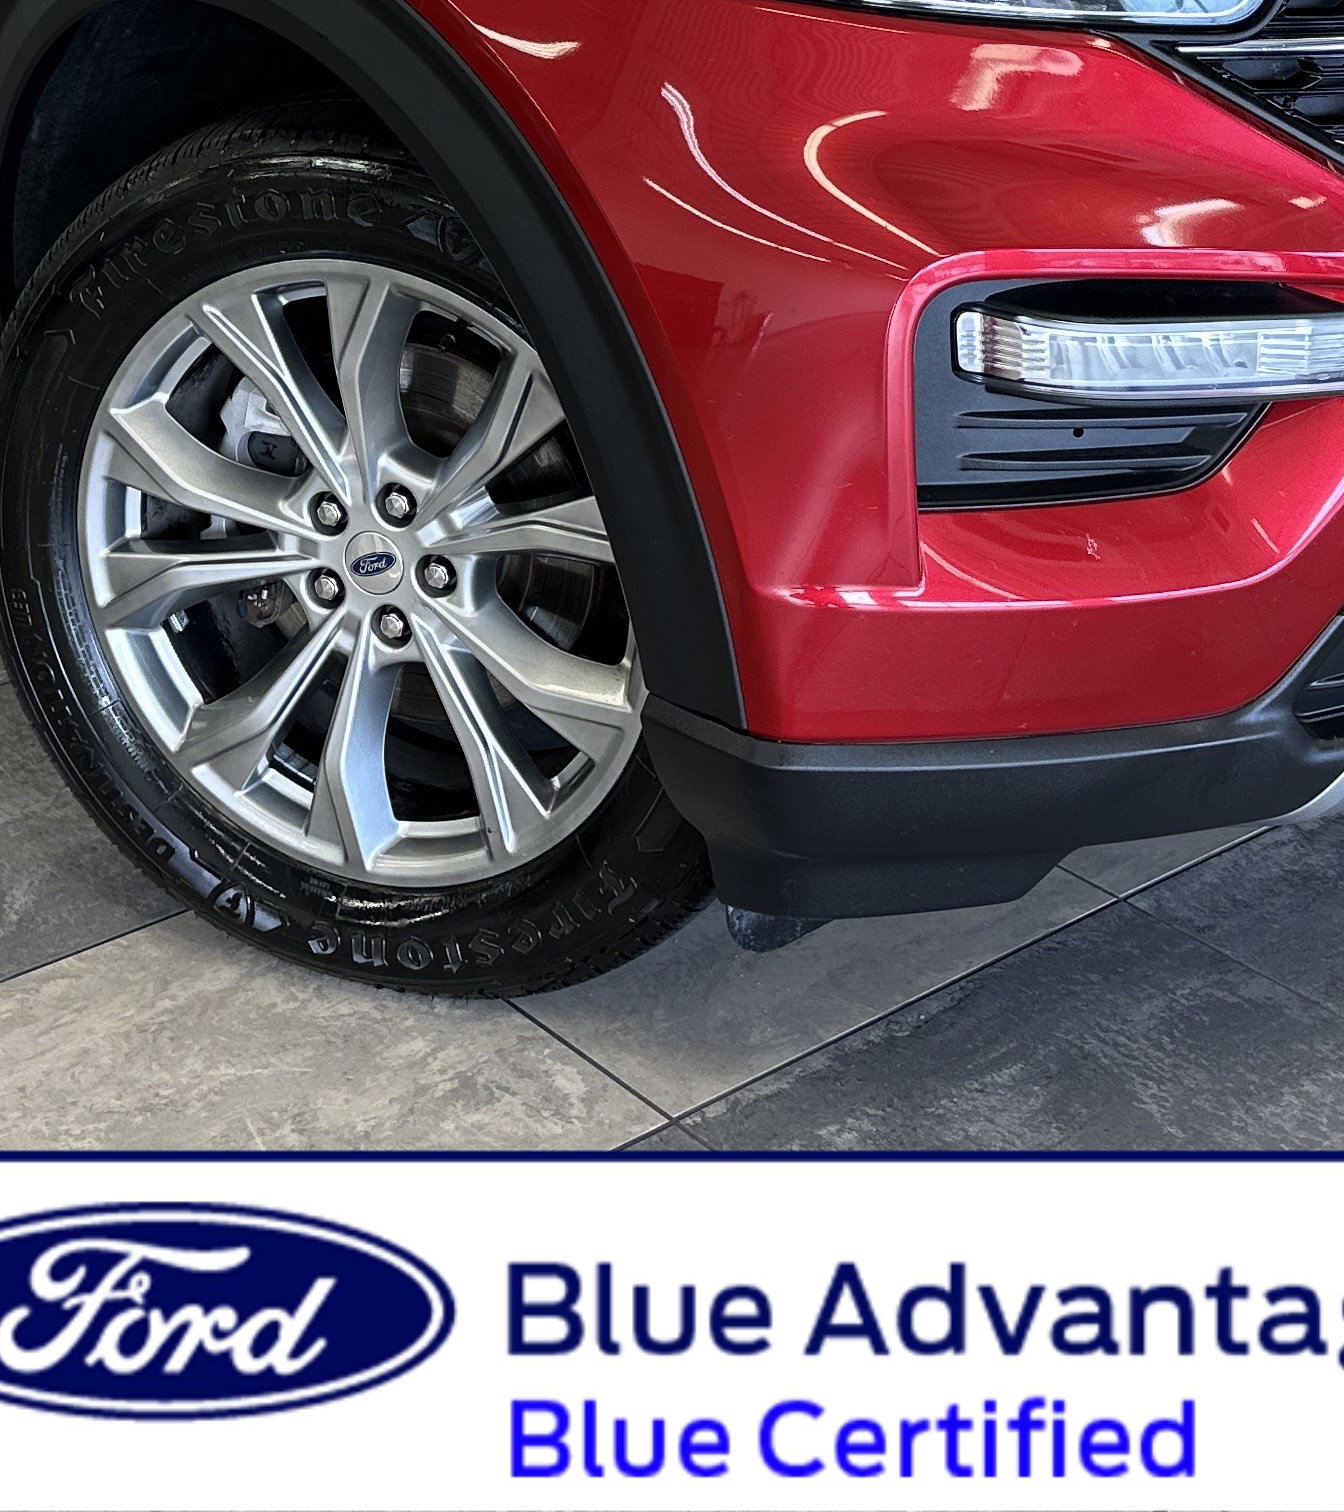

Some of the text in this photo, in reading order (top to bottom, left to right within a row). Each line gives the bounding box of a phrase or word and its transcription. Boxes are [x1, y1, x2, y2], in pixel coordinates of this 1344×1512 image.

[68, 186, 386, 320] Firestone
[359, 556, 387, 574] Ford
[308, 859, 639, 974] Firestone
